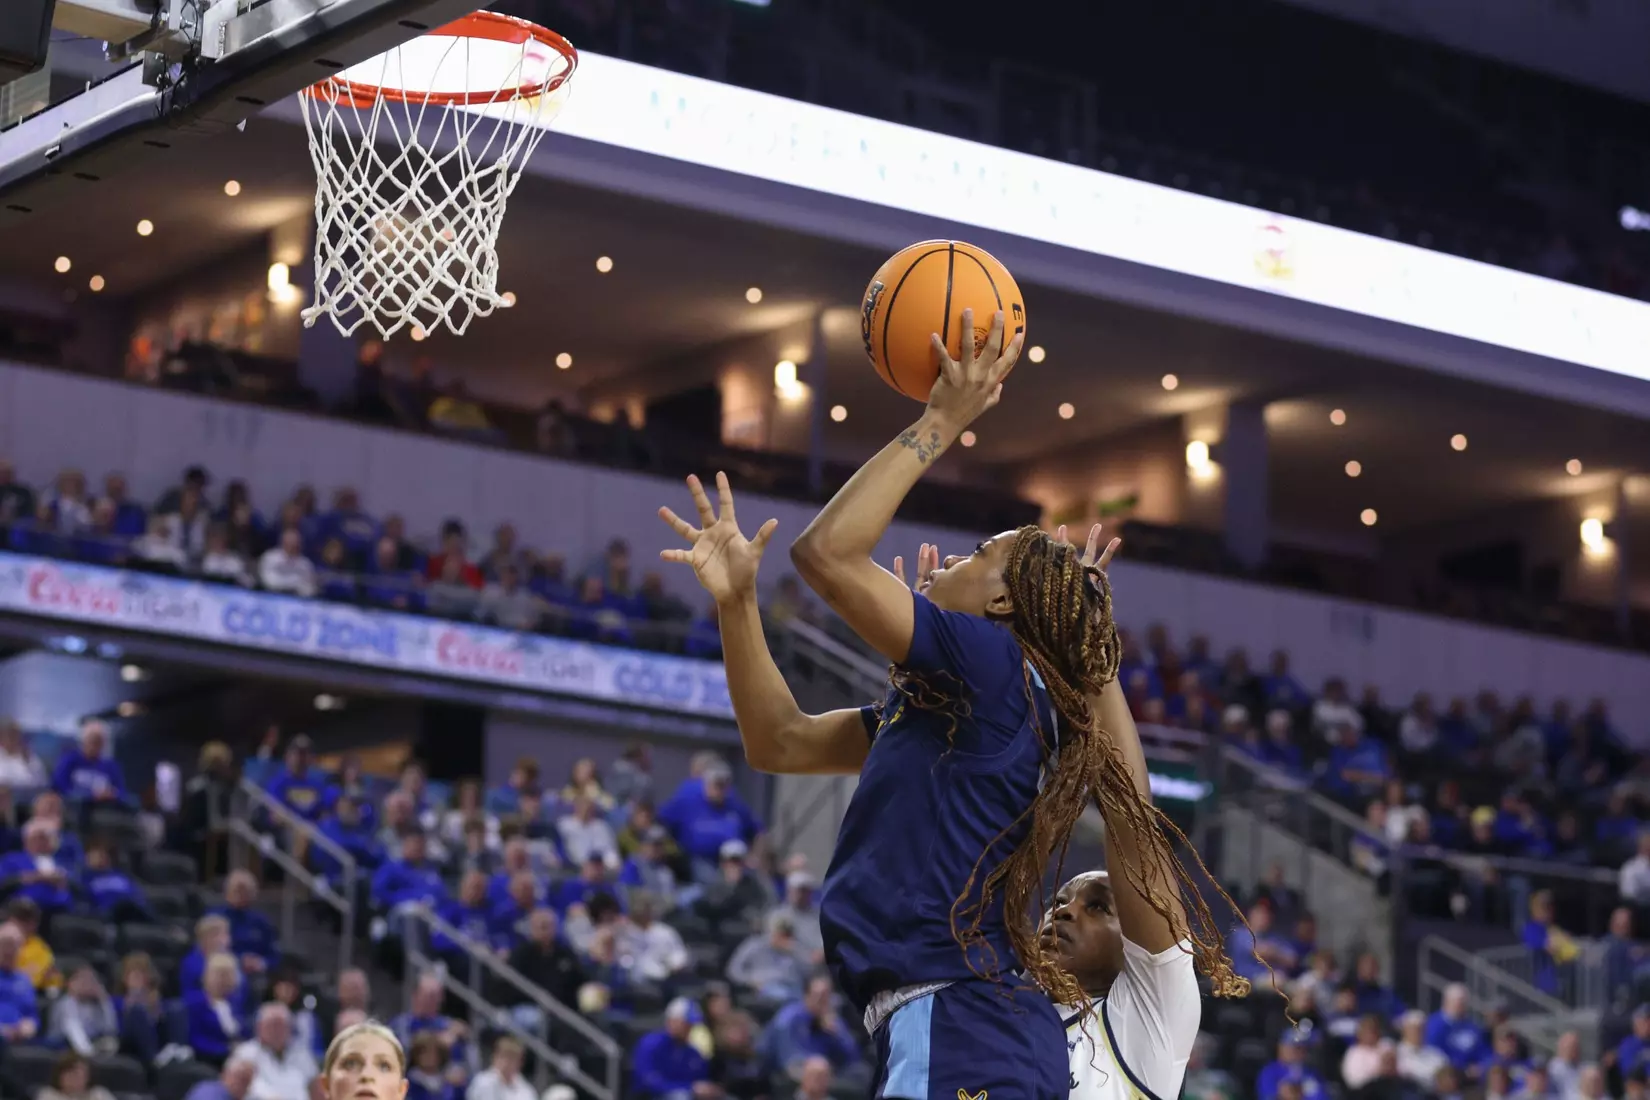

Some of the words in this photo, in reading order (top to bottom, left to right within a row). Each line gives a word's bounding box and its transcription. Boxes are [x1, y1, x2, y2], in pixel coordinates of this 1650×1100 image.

[222, 602, 310, 642] COLD
[317, 613, 396, 658] ZONE
[613, 662, 694, 701] COLD
